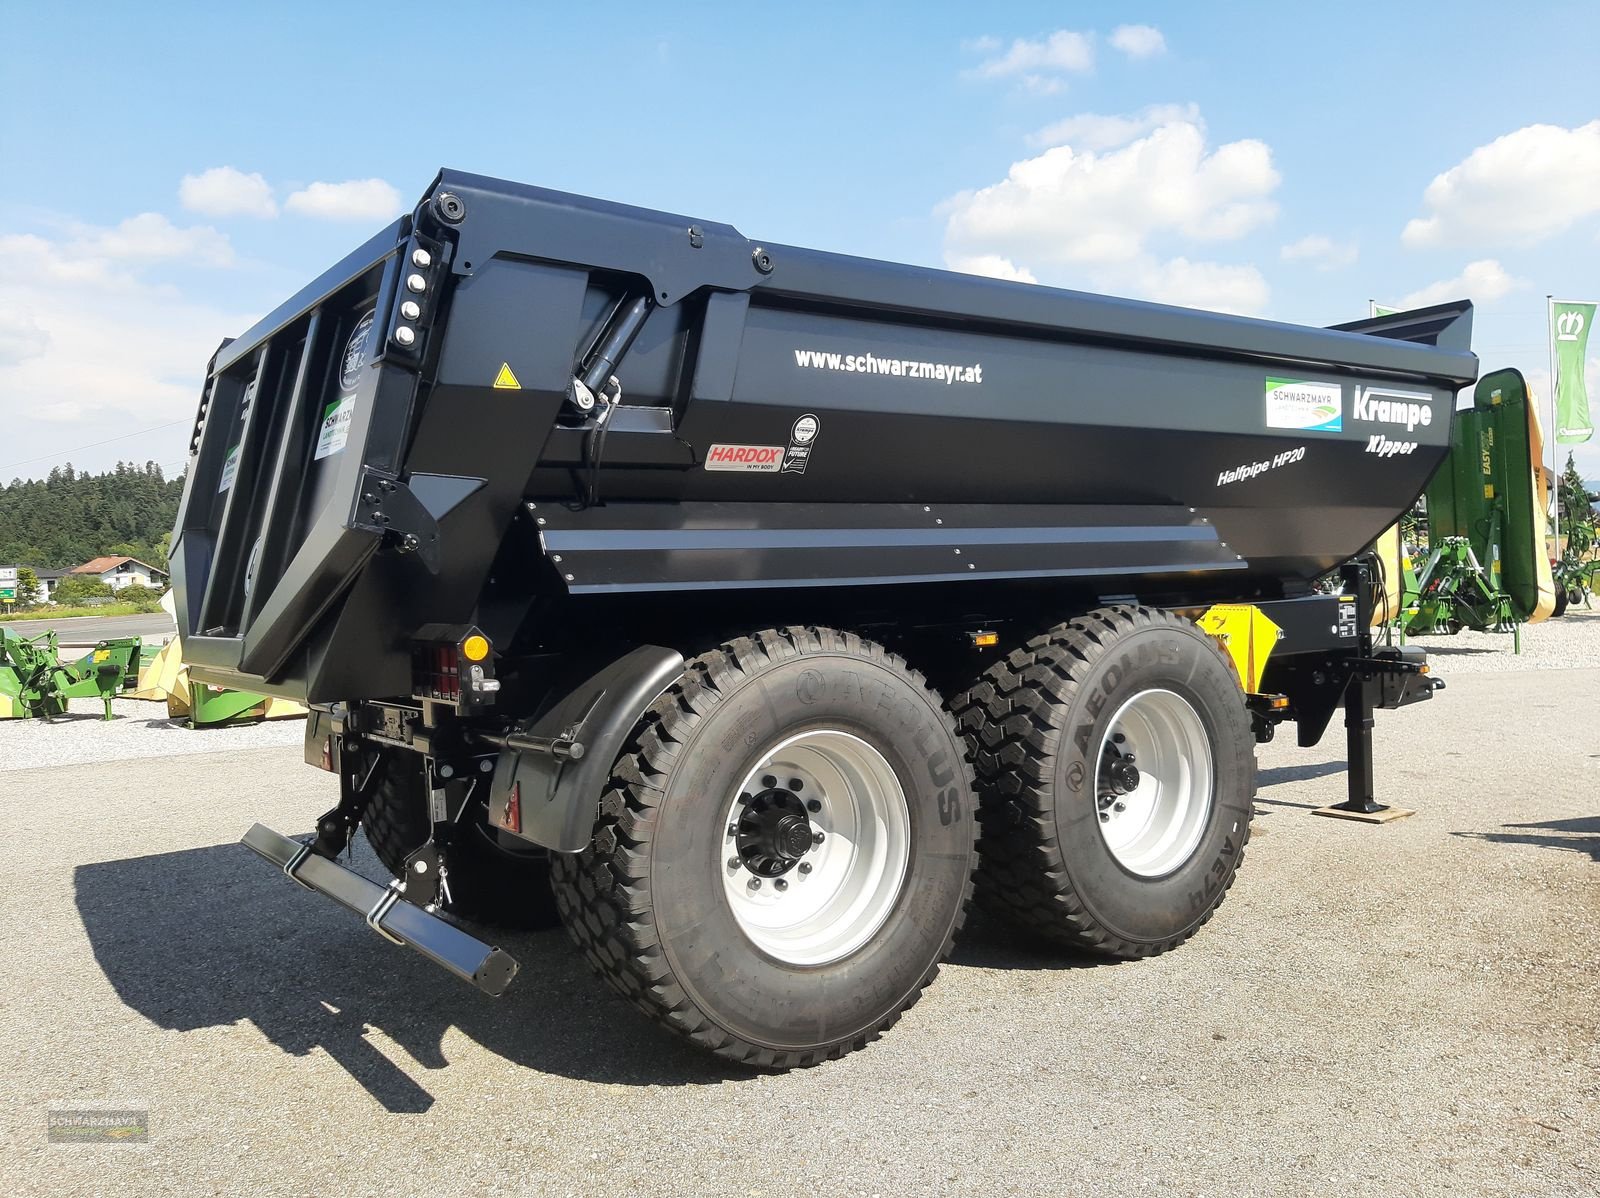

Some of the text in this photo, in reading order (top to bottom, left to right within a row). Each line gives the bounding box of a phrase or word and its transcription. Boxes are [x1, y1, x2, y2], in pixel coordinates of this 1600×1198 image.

[794, 350, 983, 384] www.schwarzmayr.at
[1274, 391, 1332, 404] SCHWARZMAYR
[1353, 385, 1433, 432] Krampe
[709, 447, 780, 463] HARDOX
[1366, 434, 1418, 457] Kipper
[1216, 447, 1305, 487] Halfpipe HP20
[1073, 638, 1180, 758] AEOLUS
